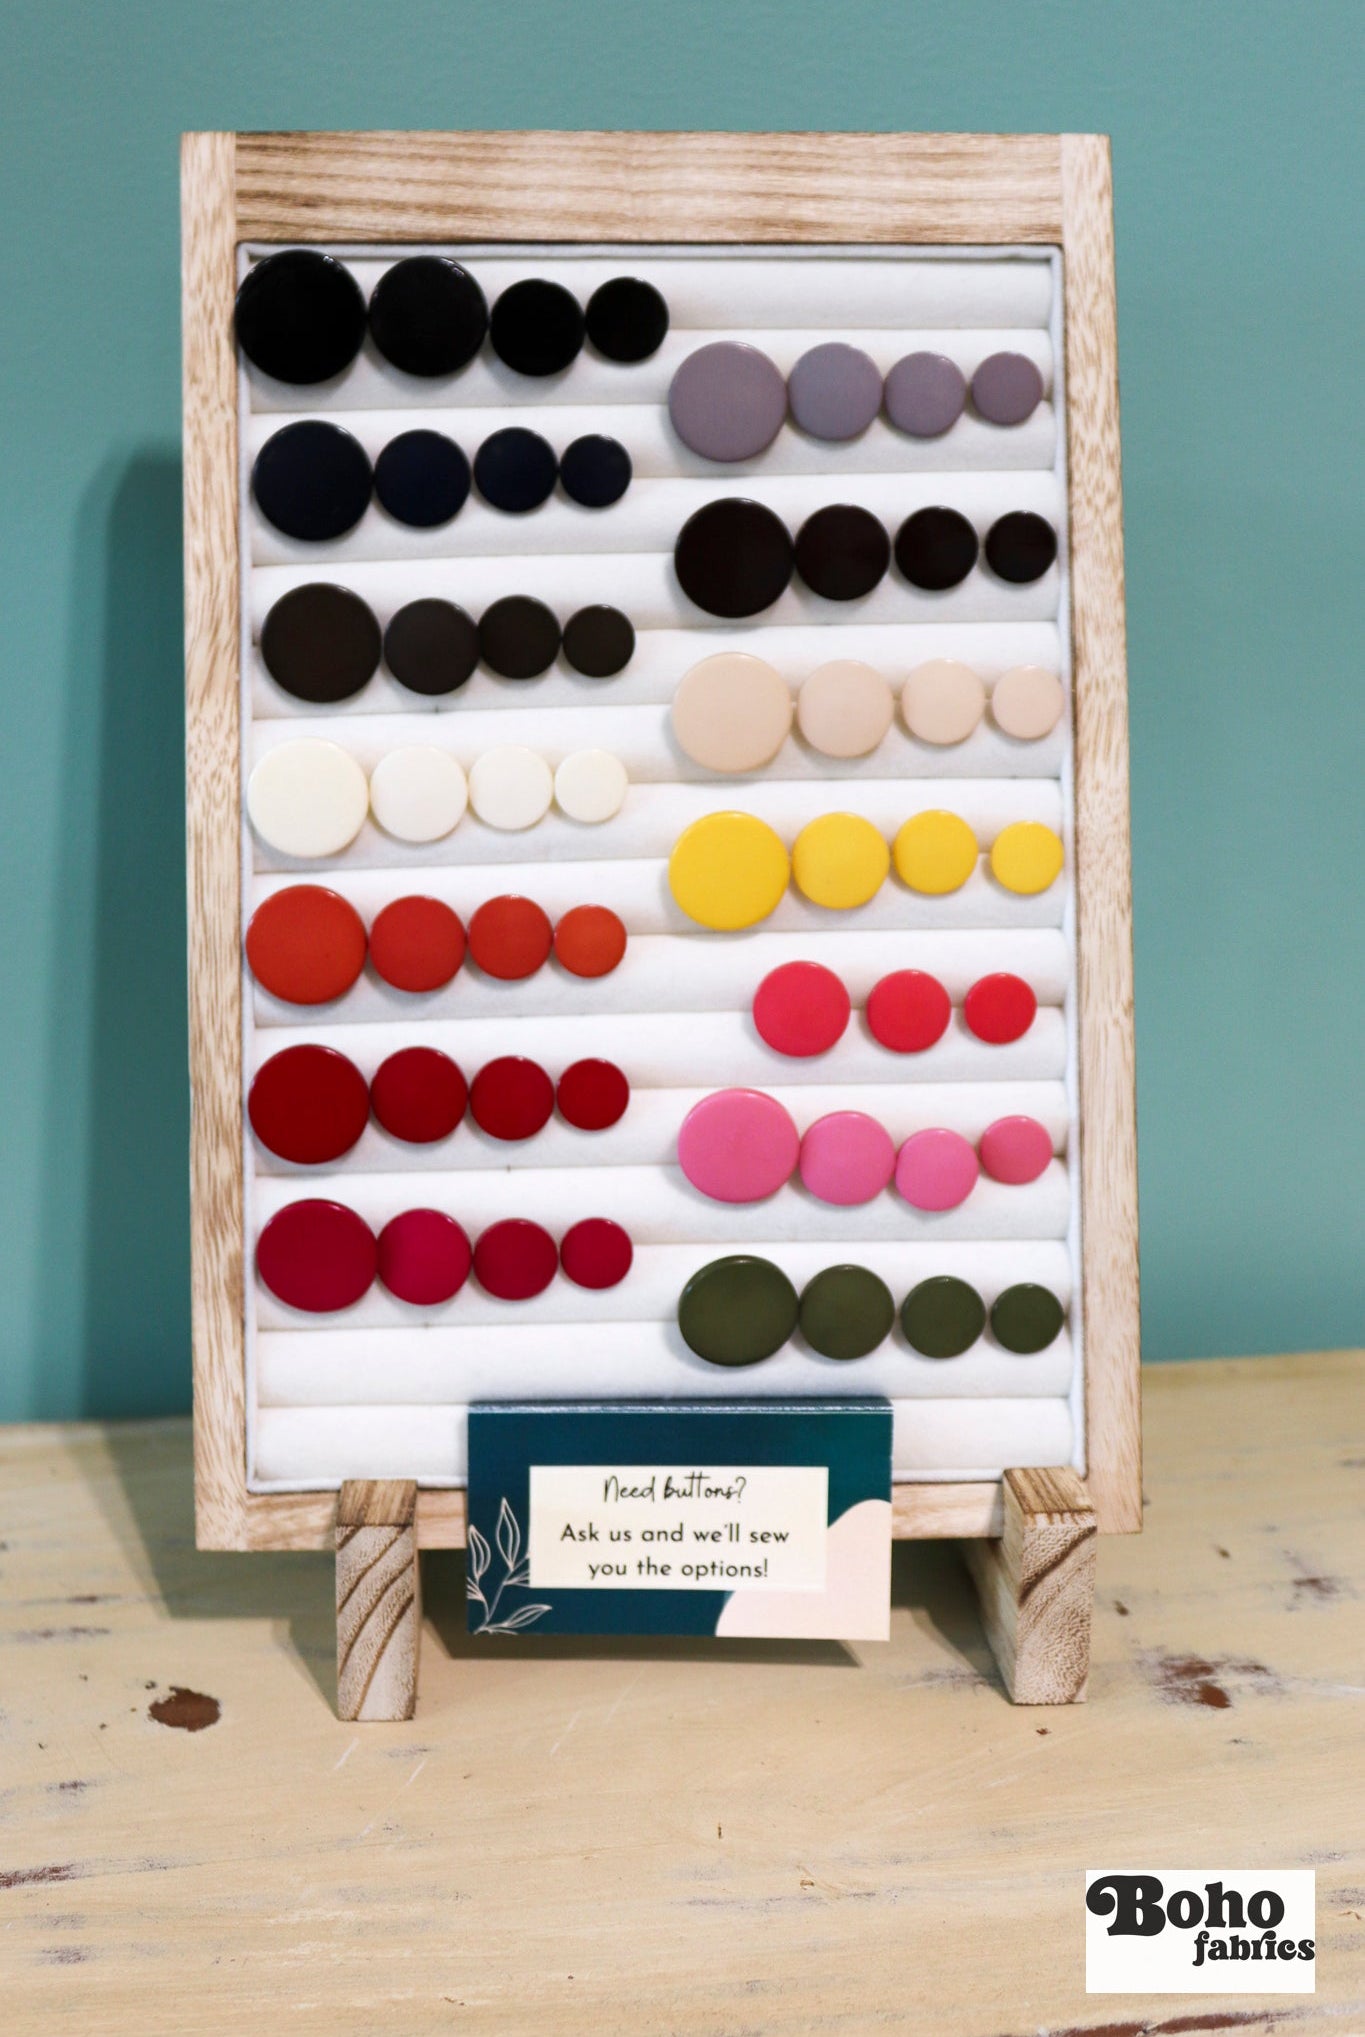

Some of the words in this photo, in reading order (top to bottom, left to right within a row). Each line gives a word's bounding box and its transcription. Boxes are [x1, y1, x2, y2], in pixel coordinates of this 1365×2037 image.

[603, 1476, 655, 1503] Need
[663, 1470, 747, 1504] buttons?
[560, 1522, 599, 1542] Ask
[609, 1528, 632, 1542] us
[641, 1523, 684, 1543] and
[693, 1523, 740, 1544] we'll
[749, 1529, 790, 1544] sew
[588, 1561, 627, 1580] you
[637, 1556, 671, 1577] the
[681, 1558, 769, 1580] options!
